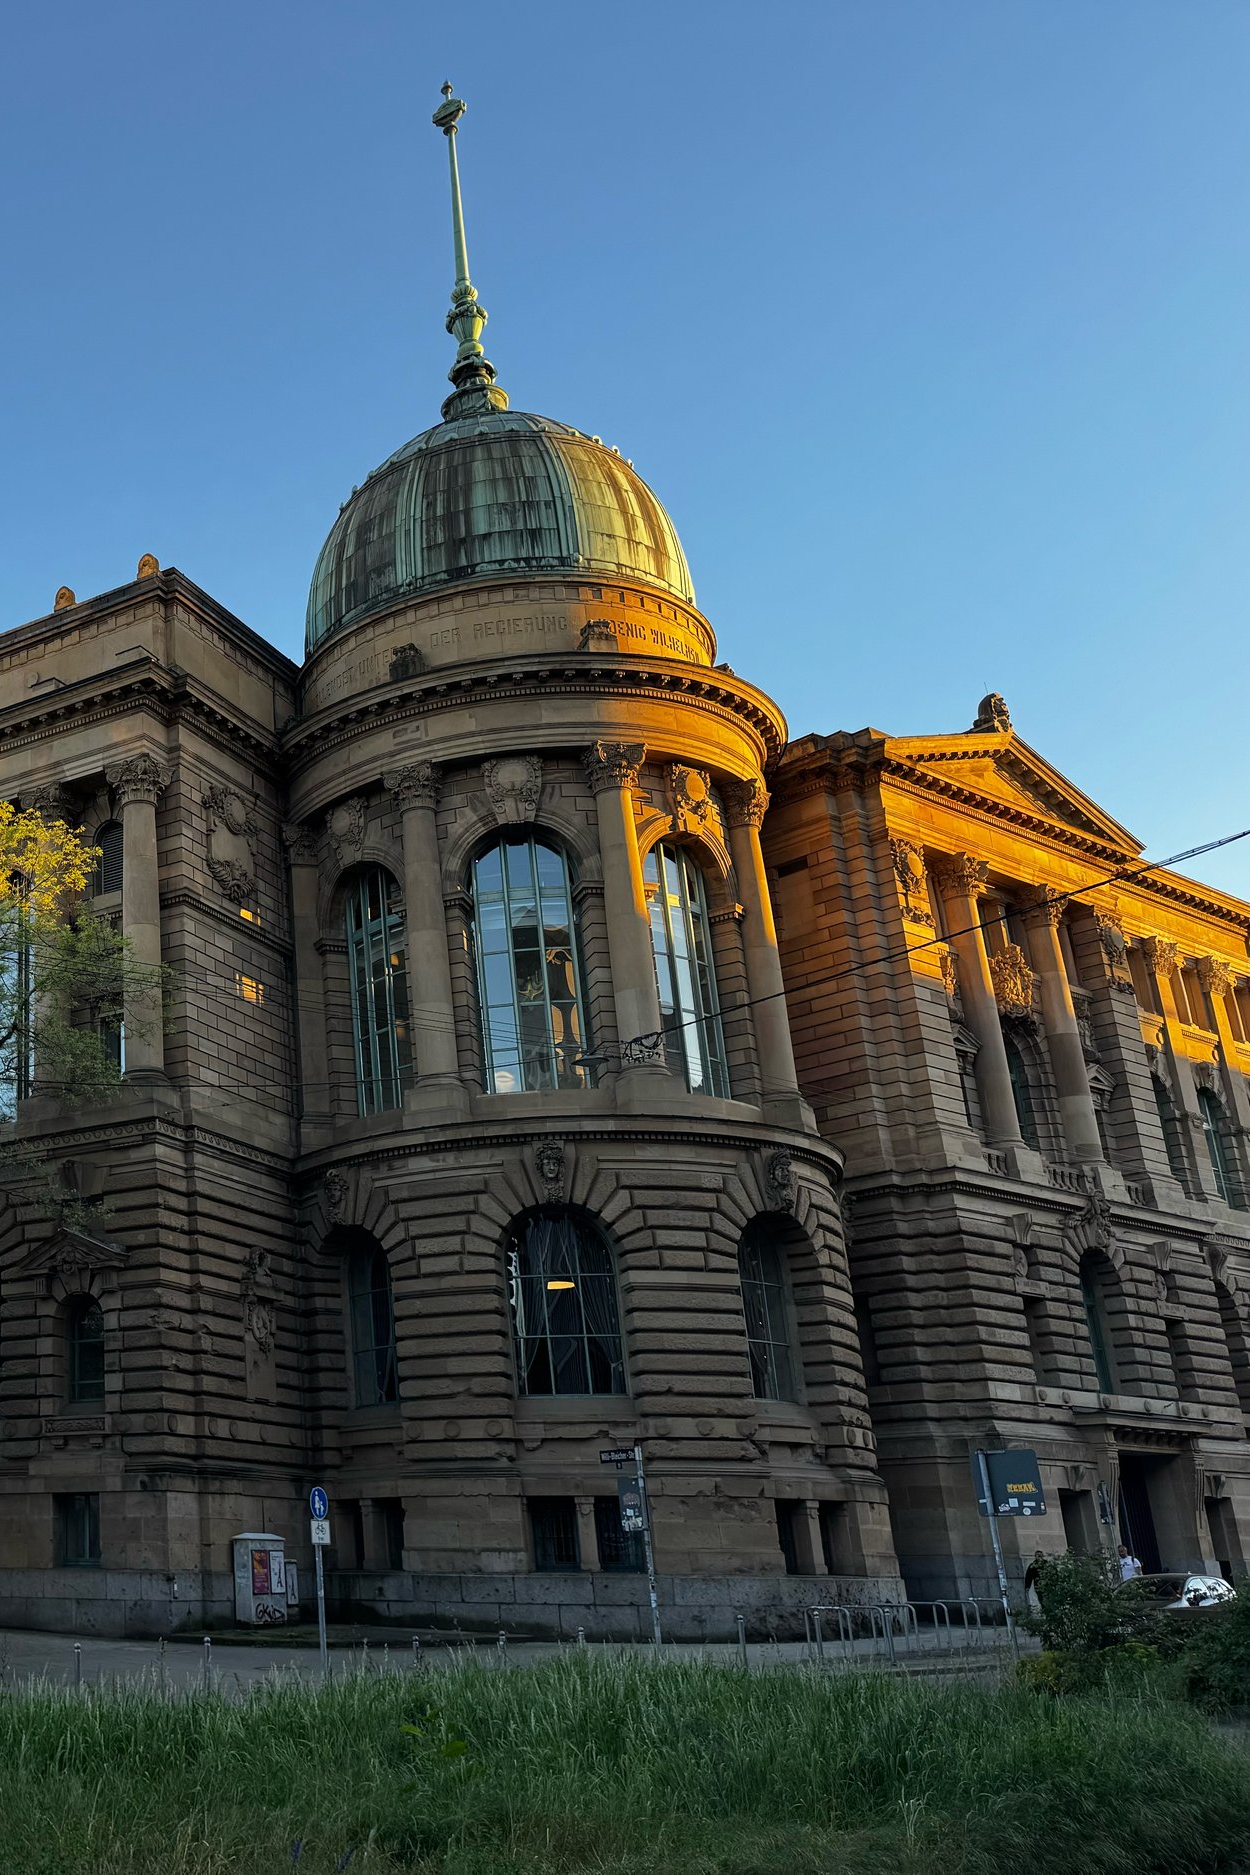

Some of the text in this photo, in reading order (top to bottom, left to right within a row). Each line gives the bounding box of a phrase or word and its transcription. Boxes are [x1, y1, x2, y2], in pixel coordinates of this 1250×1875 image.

[430, 627, 462, 648] DER
[474, 615, 568, 640] REGIERUNG
[601, 618, 646, 641] OENIG
